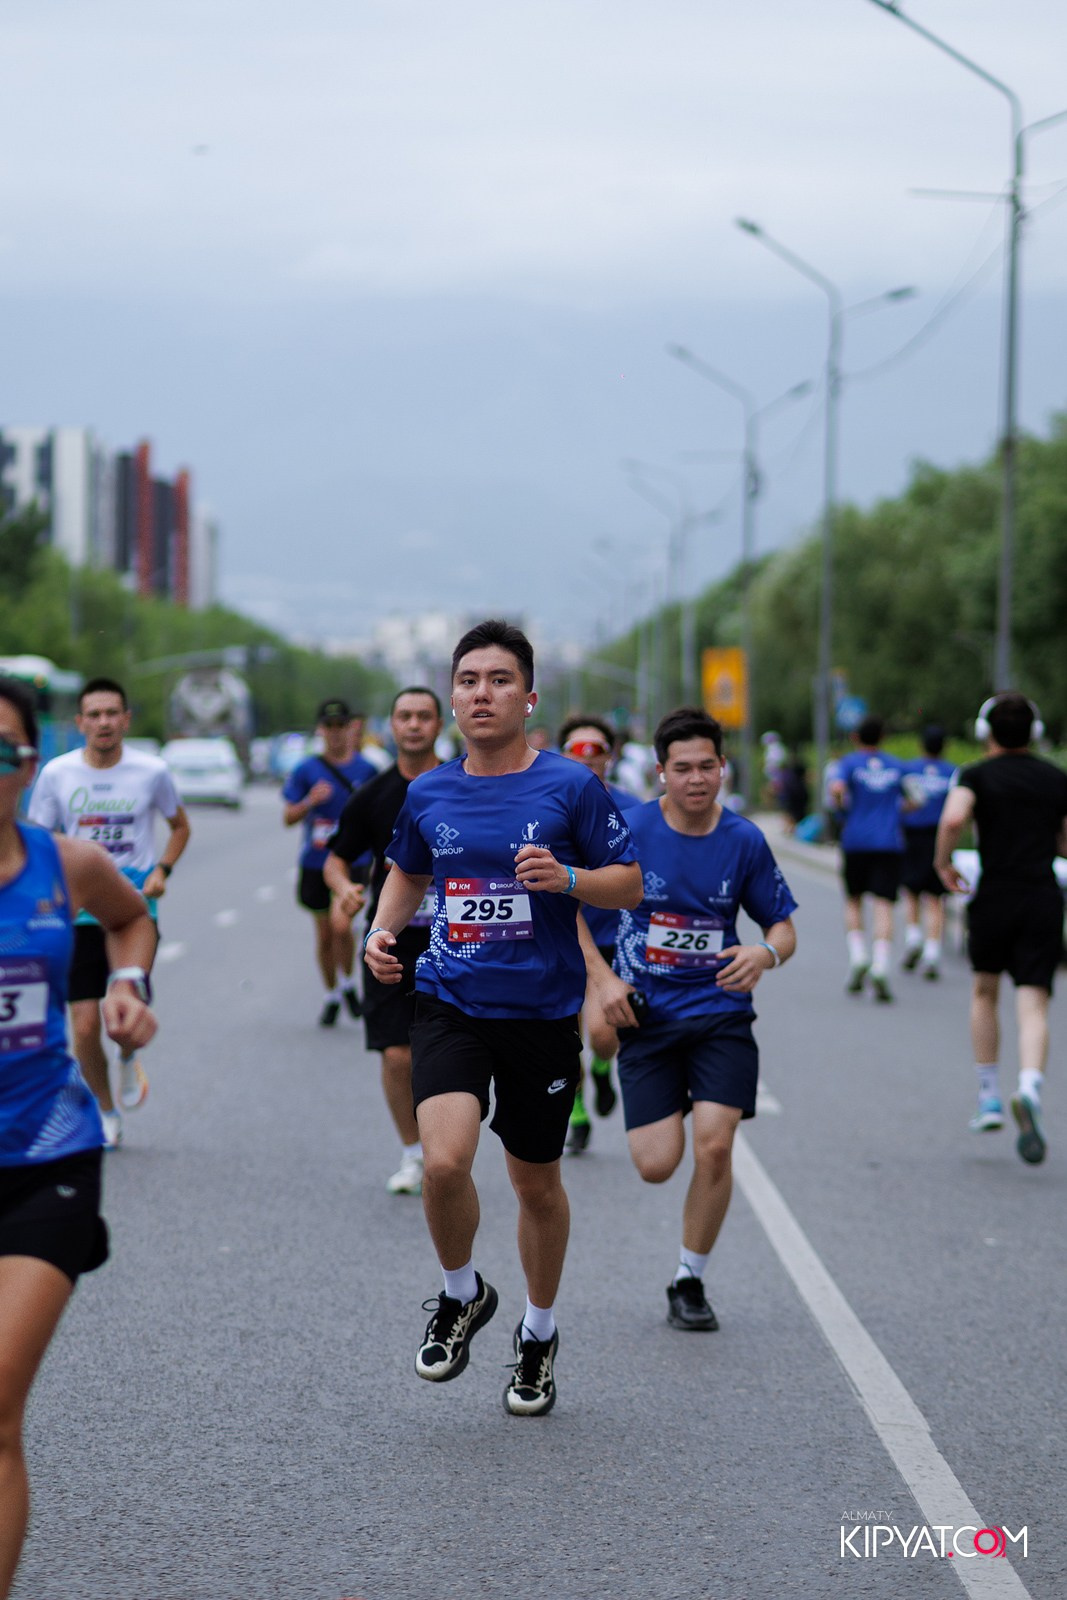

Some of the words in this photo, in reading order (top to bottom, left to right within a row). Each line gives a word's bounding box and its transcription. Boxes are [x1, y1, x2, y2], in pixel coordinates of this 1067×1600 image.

[438, 847, 463, 856] GROUP
[448, 882, 457, 891] 10
[460, 897, 514, 921] 295
[660, 931, 710, 951] 226
